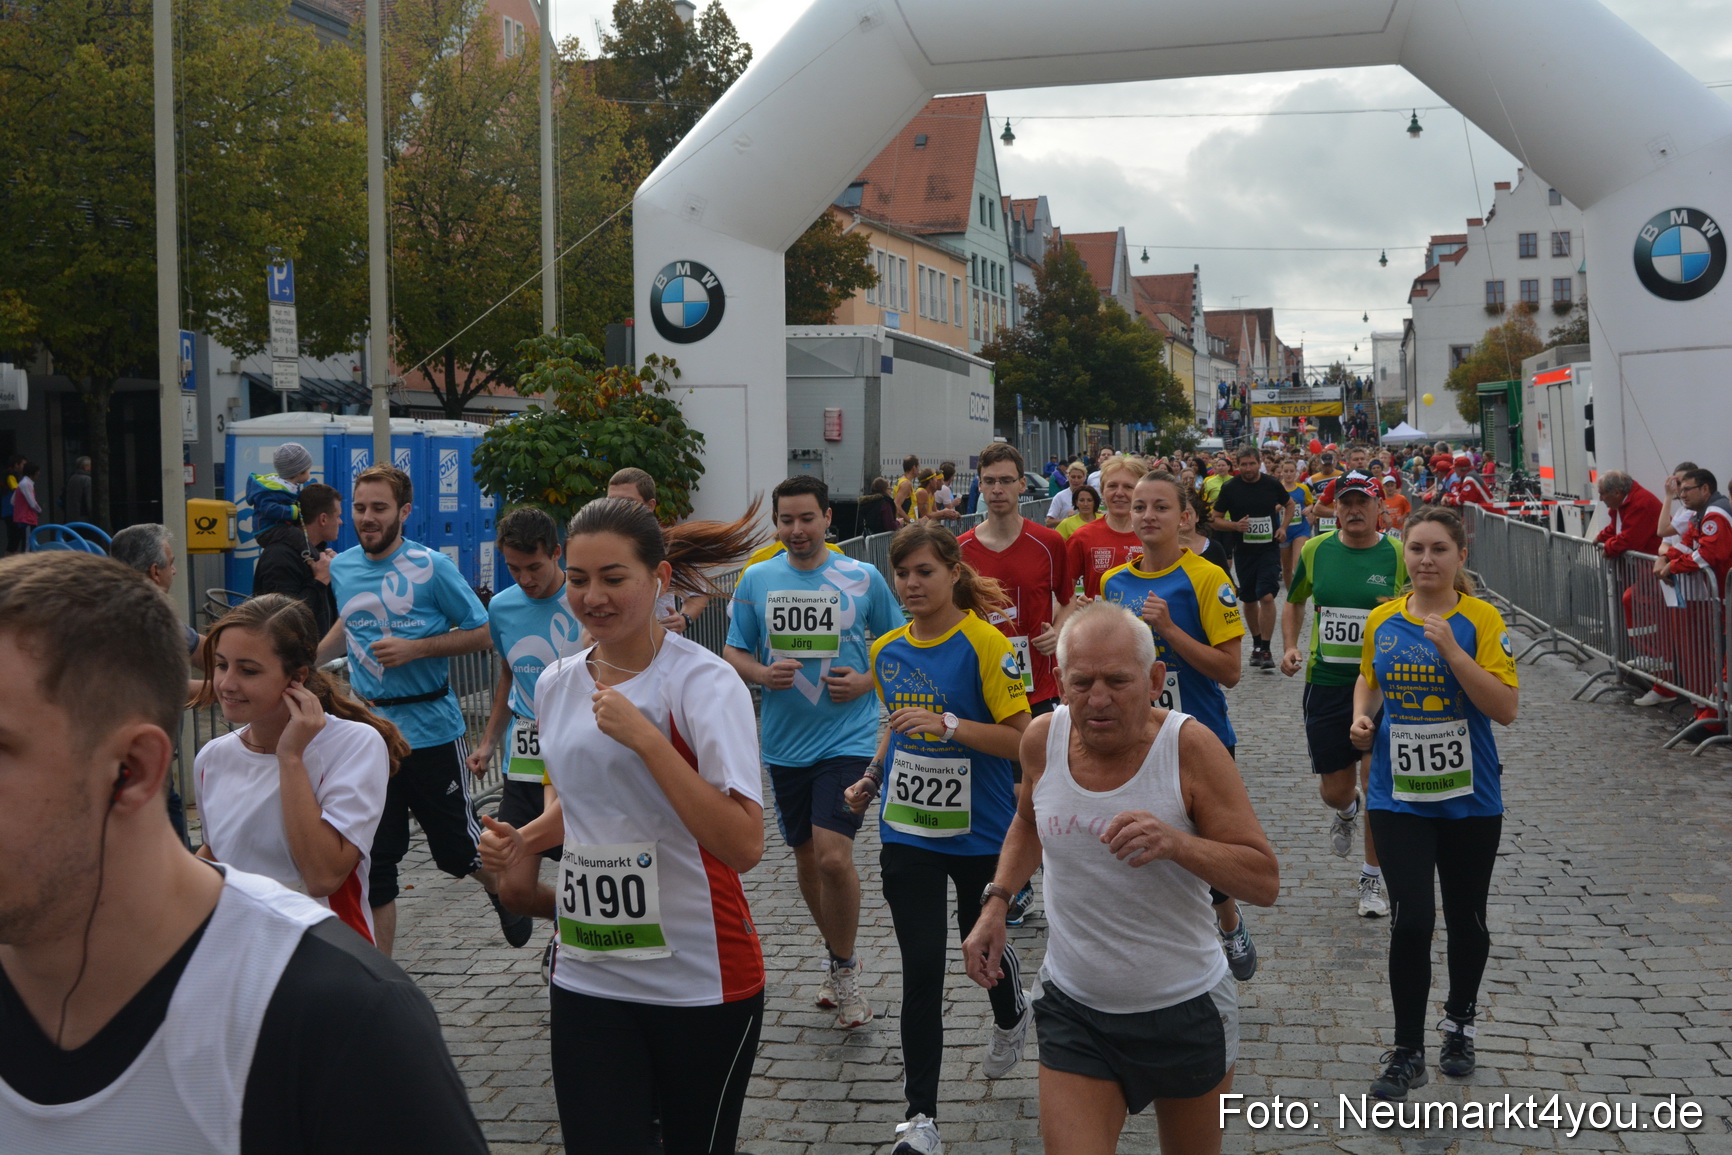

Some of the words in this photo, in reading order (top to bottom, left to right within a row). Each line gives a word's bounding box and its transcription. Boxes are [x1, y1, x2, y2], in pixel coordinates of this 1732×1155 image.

[1641, 210, 1719, 243] BMW
[654, 262, 718, 290] BMW
[1281, 405, 1312, 414] START
[217, 414, 225, 433] 3
[440, 452, 458, 476] DIXI
[767, 596, 791, 604] PARTL
[791, 596, 827, 604] Neumarkt
[346, 617, 377, 627] anders
[391, 618, 427, 628] andere
[772, 606, 834, 632] 5064
[791, 638, 813, 650] Jörg
[1391, 732, 1413, 740] PARTL
[1414, 731, 1455, 740] Neumarkt
[1397, 740, 1464, 773] 5153
[894, 758, 914, 771] PARTL
[914, 764, 954, 775] Neumarkt
[896, 771, 962, 808] 5222
[1408, 777, 1455, 791] Veronika
[913, 811, 939, 827] Julia
[578, 855, 632, 868] Neumarkt
[562, 868, 647, 919] 5190
[575, 926, 635, 947] Nathalie
